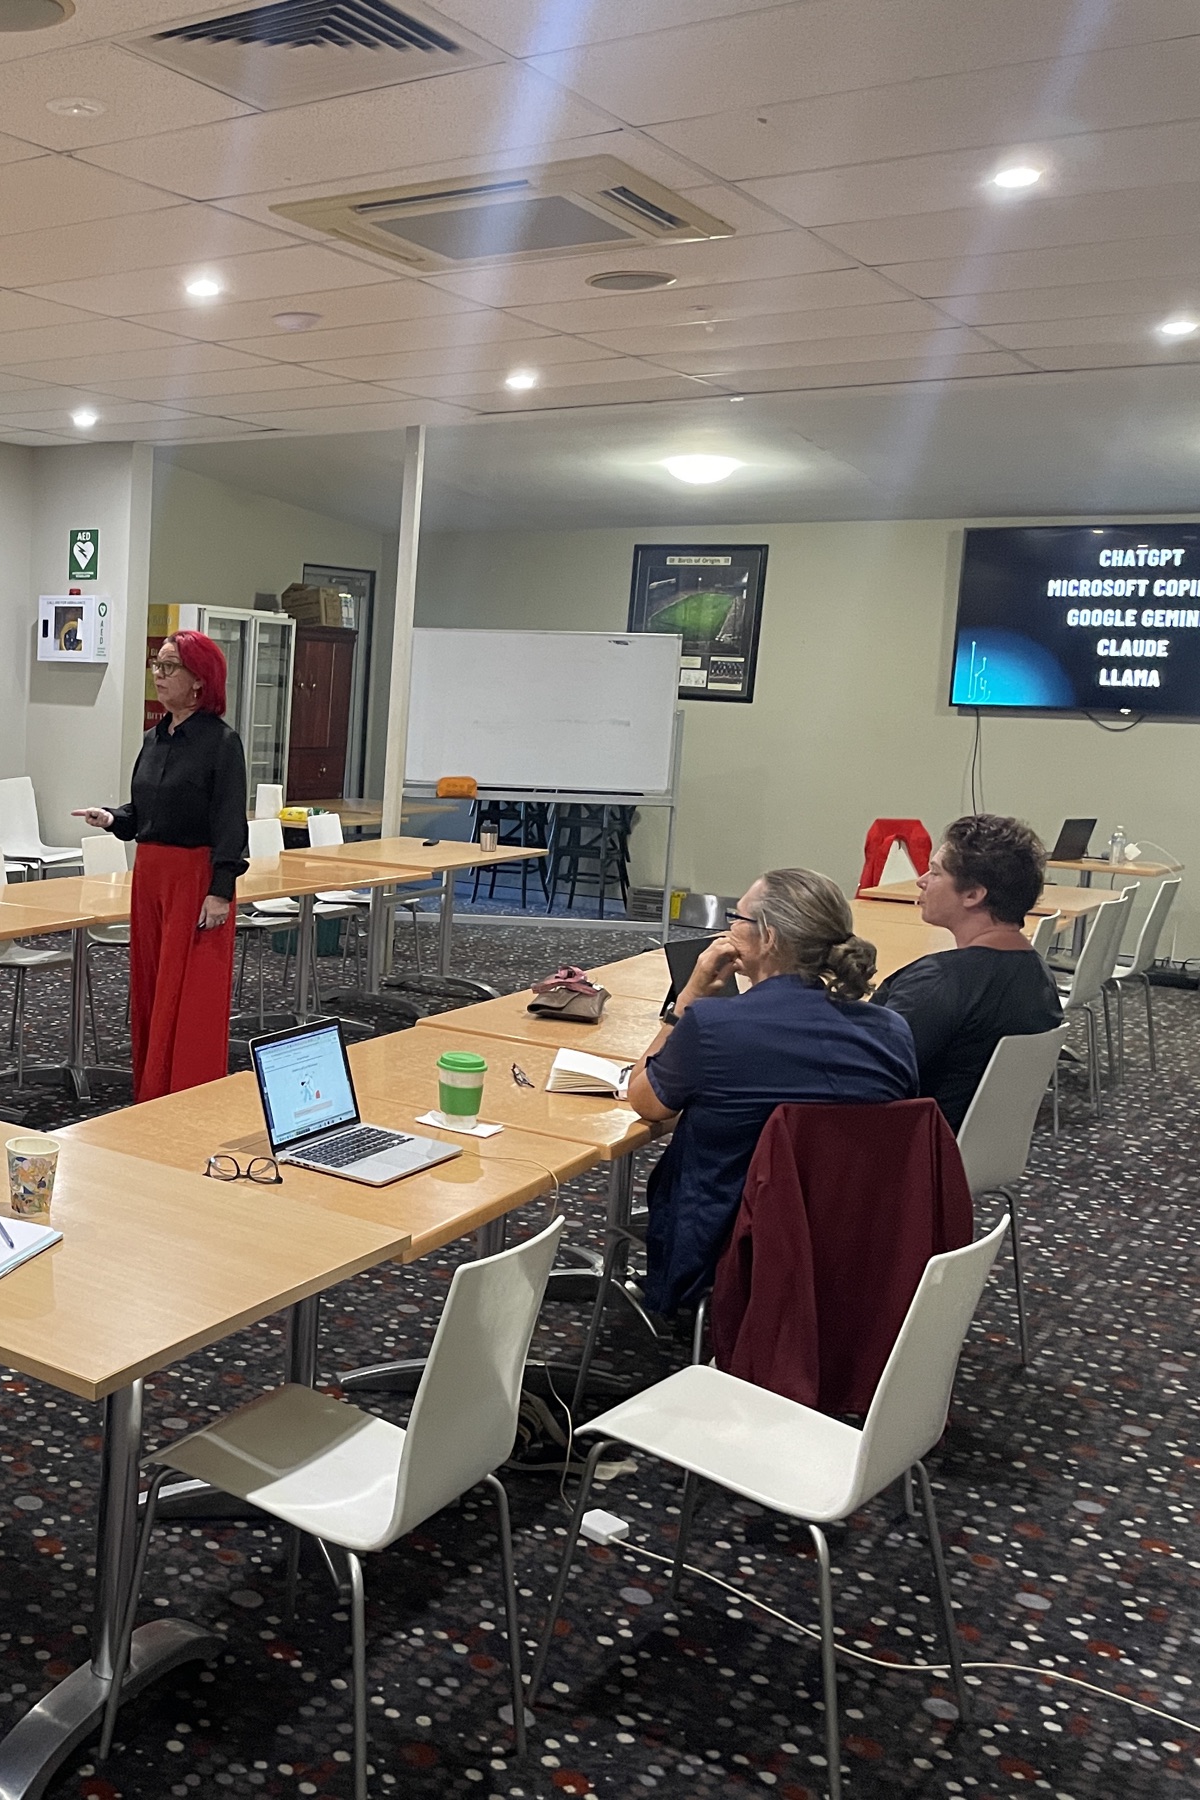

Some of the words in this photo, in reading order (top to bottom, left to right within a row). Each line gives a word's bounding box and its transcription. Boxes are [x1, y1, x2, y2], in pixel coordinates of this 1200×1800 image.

[77, 531, 91, 541] AED
[1098, 548, 1186, 568] CHATGPT
[1046, 579, 1150, 597] MICROSOFT
[1152, 579, 1200, 597] COPI
[1066, 608, 1138, 627] GOOGLE
[1141, 608, 1200, 628] GEMIN
[1096, 638, 1170, 658] CLAUDE
[1098, 668, 1161, 688] LLAMA
